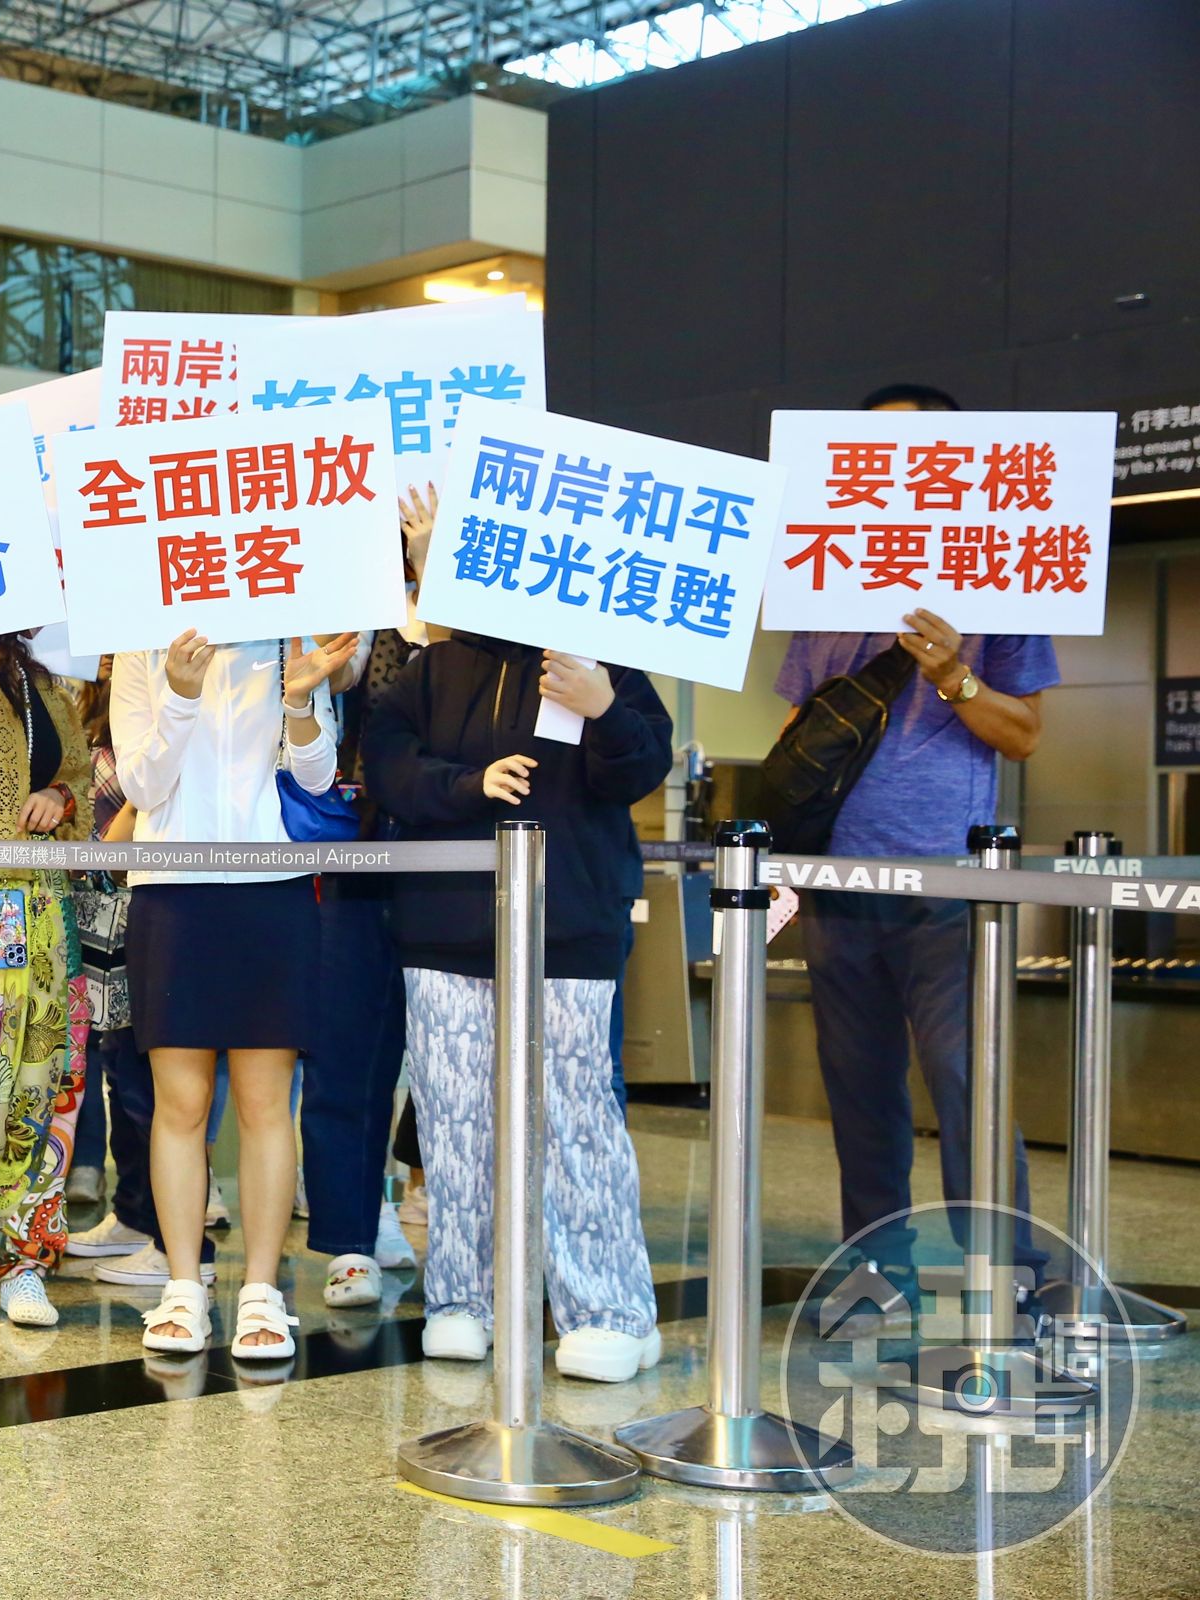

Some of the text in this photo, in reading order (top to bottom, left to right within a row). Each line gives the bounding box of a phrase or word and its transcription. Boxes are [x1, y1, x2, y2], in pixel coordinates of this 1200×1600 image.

[122, 339, 237, 388] 兩岸
[80, 435, 376, 528] 全面開放
[470, 436, 755, 555] 兩岸和平
[826, 441, 1057, 512] 要客機
[158, 526, 304, 606] 陸客
[453, 515, 737, 639] 觀光復甦
[784, 525, 1091, 594] 不要戰機
[71, 846, 128, 863] Taiwan
[133, 847, 204, 870] Taoyuan
[209, 848, 320, 865] International
[325, 849, 391, 869] Airport
